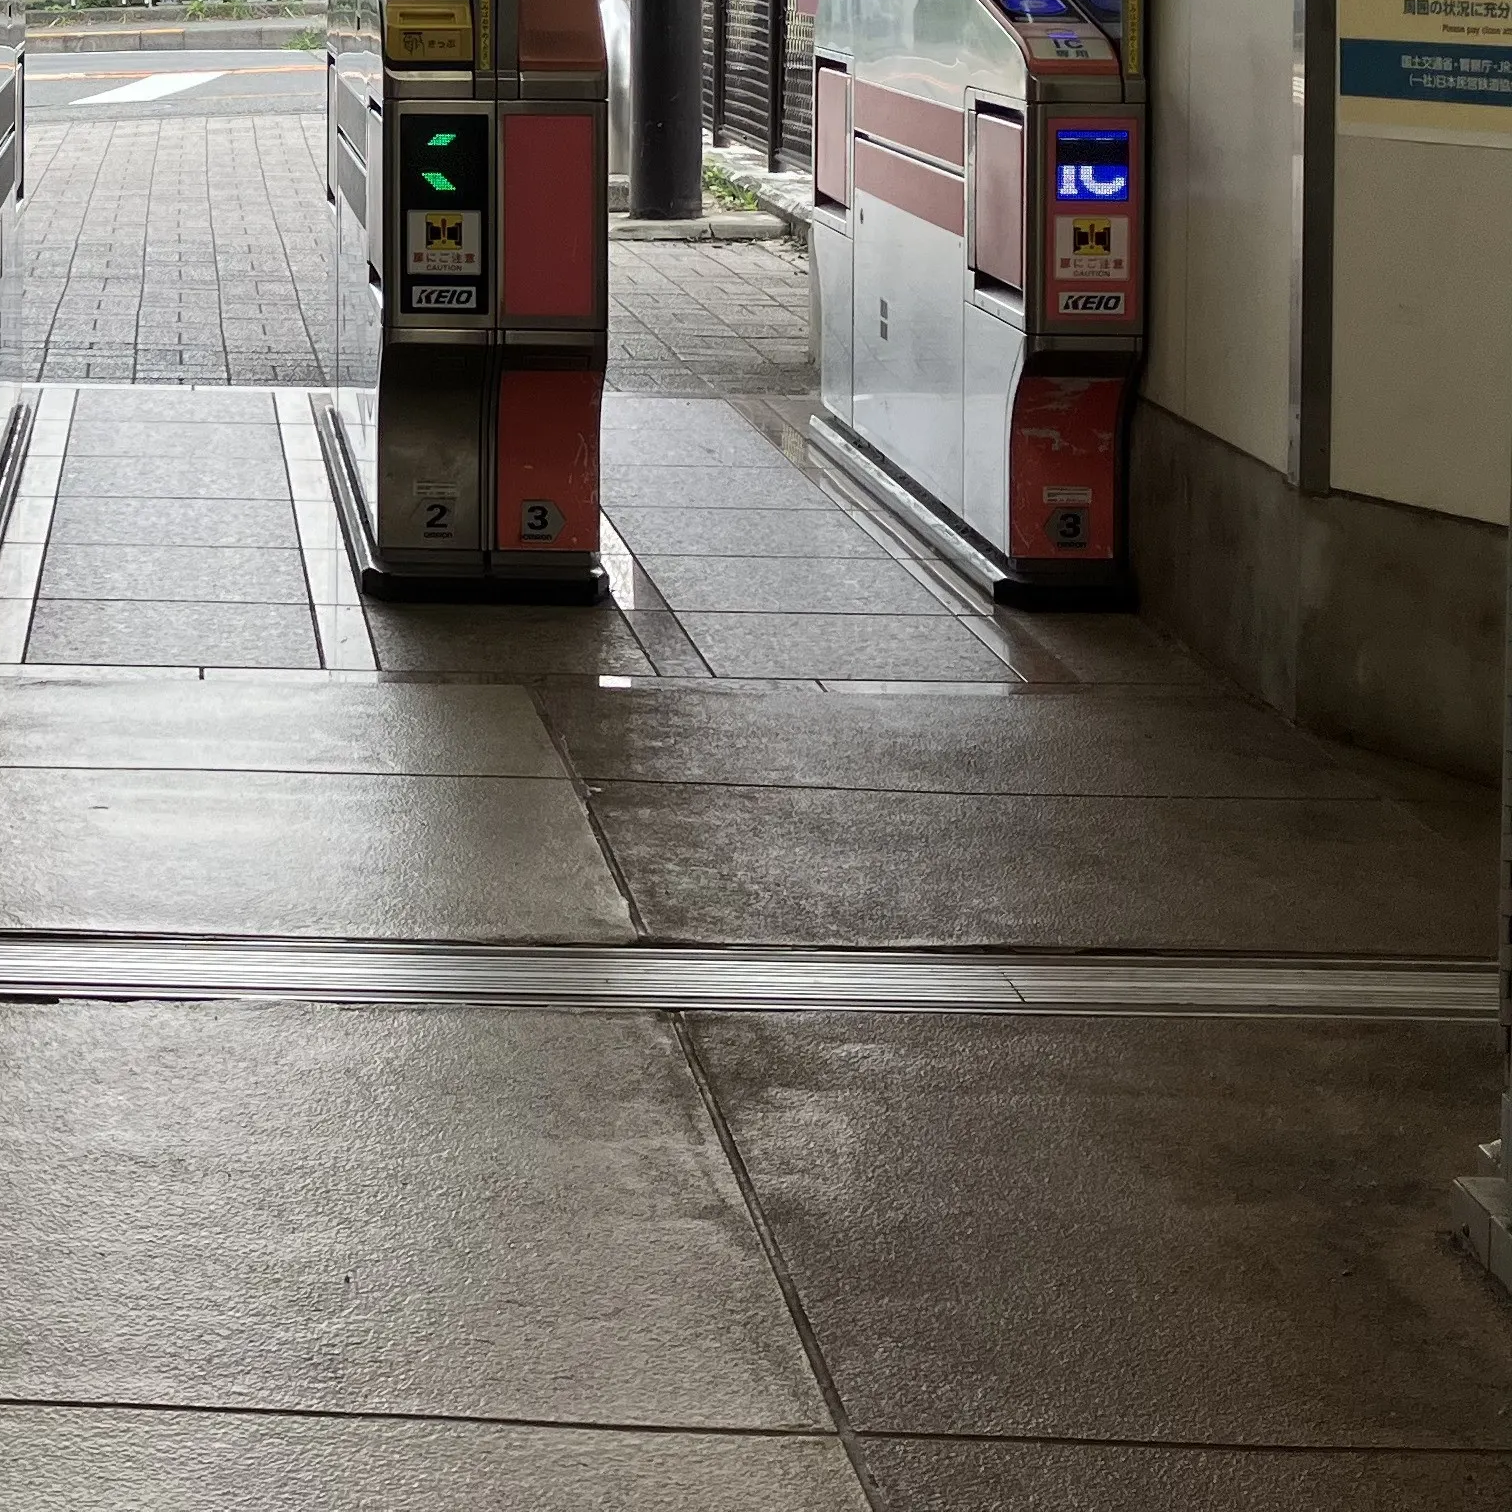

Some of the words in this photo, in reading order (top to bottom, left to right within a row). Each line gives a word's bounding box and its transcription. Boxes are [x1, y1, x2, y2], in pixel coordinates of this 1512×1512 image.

[426, 264, 463, 272] CAUTION
[416, 289, 473, 305] KEIO
[1063, 295, 1121, 310] KEIO
[426, 504, 448, 529] 2
[527, 505, 549, 530] 3
[1059, 513, 1081, 538] 3
